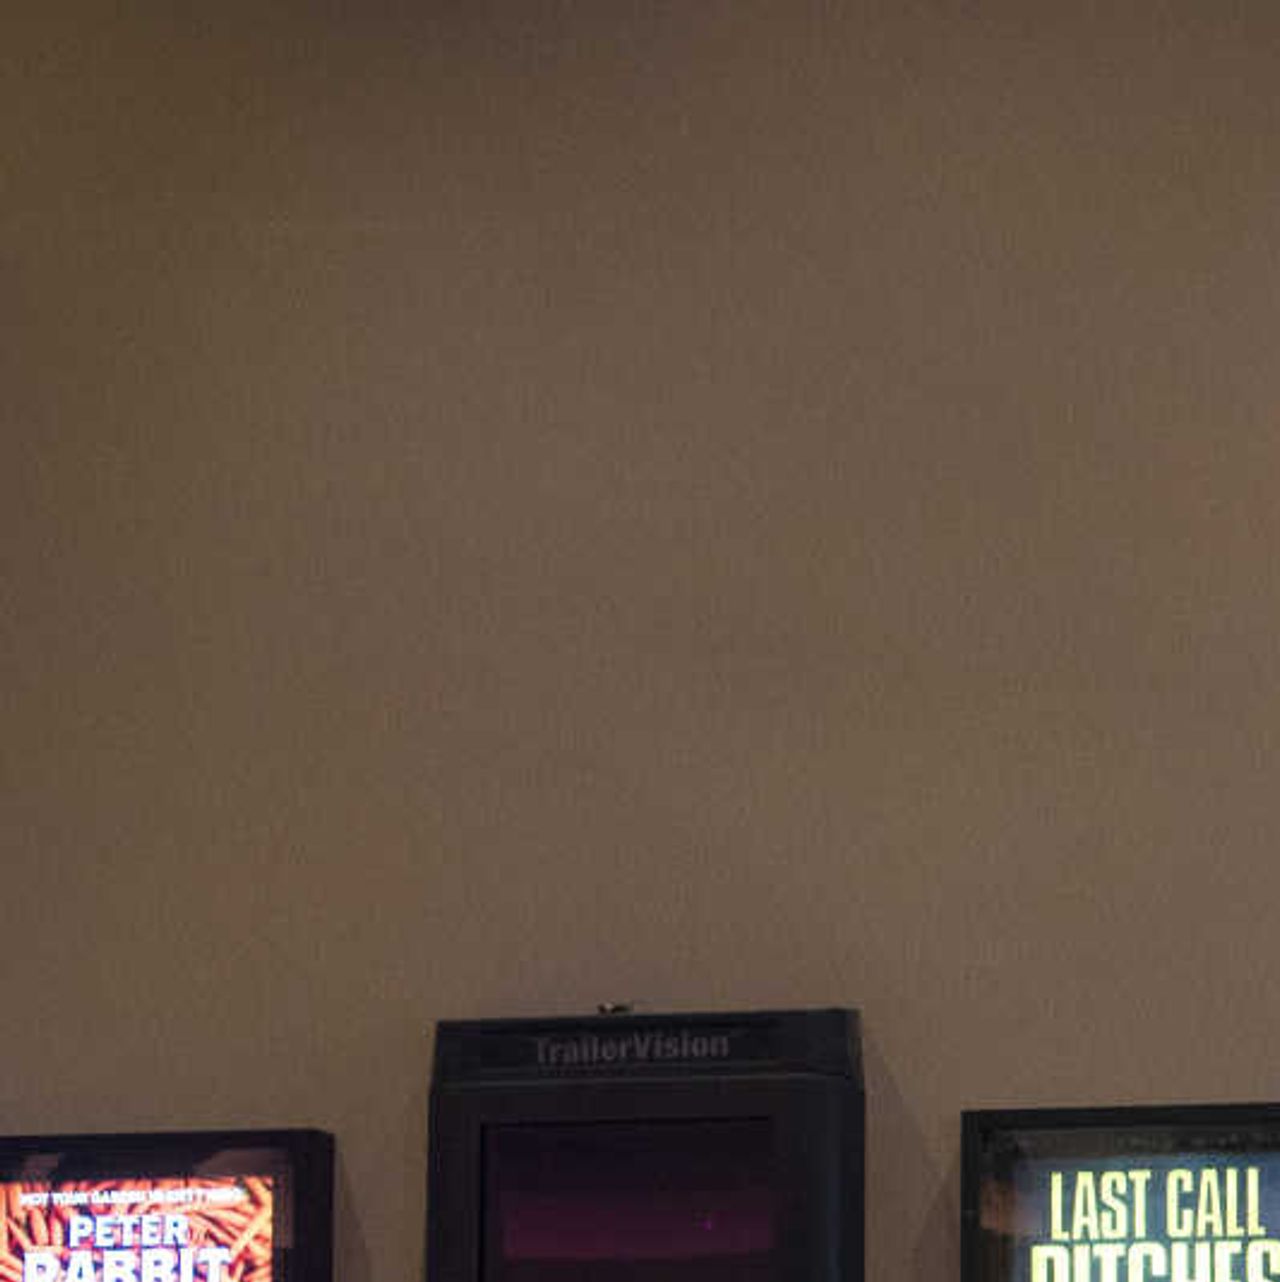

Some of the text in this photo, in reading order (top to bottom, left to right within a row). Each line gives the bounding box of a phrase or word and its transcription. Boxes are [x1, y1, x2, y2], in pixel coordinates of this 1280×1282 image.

[537, 1033, 729, 1062] TrailerVision
[1051, 1167, 1266, 1240] LAST CALL
[68, 1214, 188, 1248] PETER
